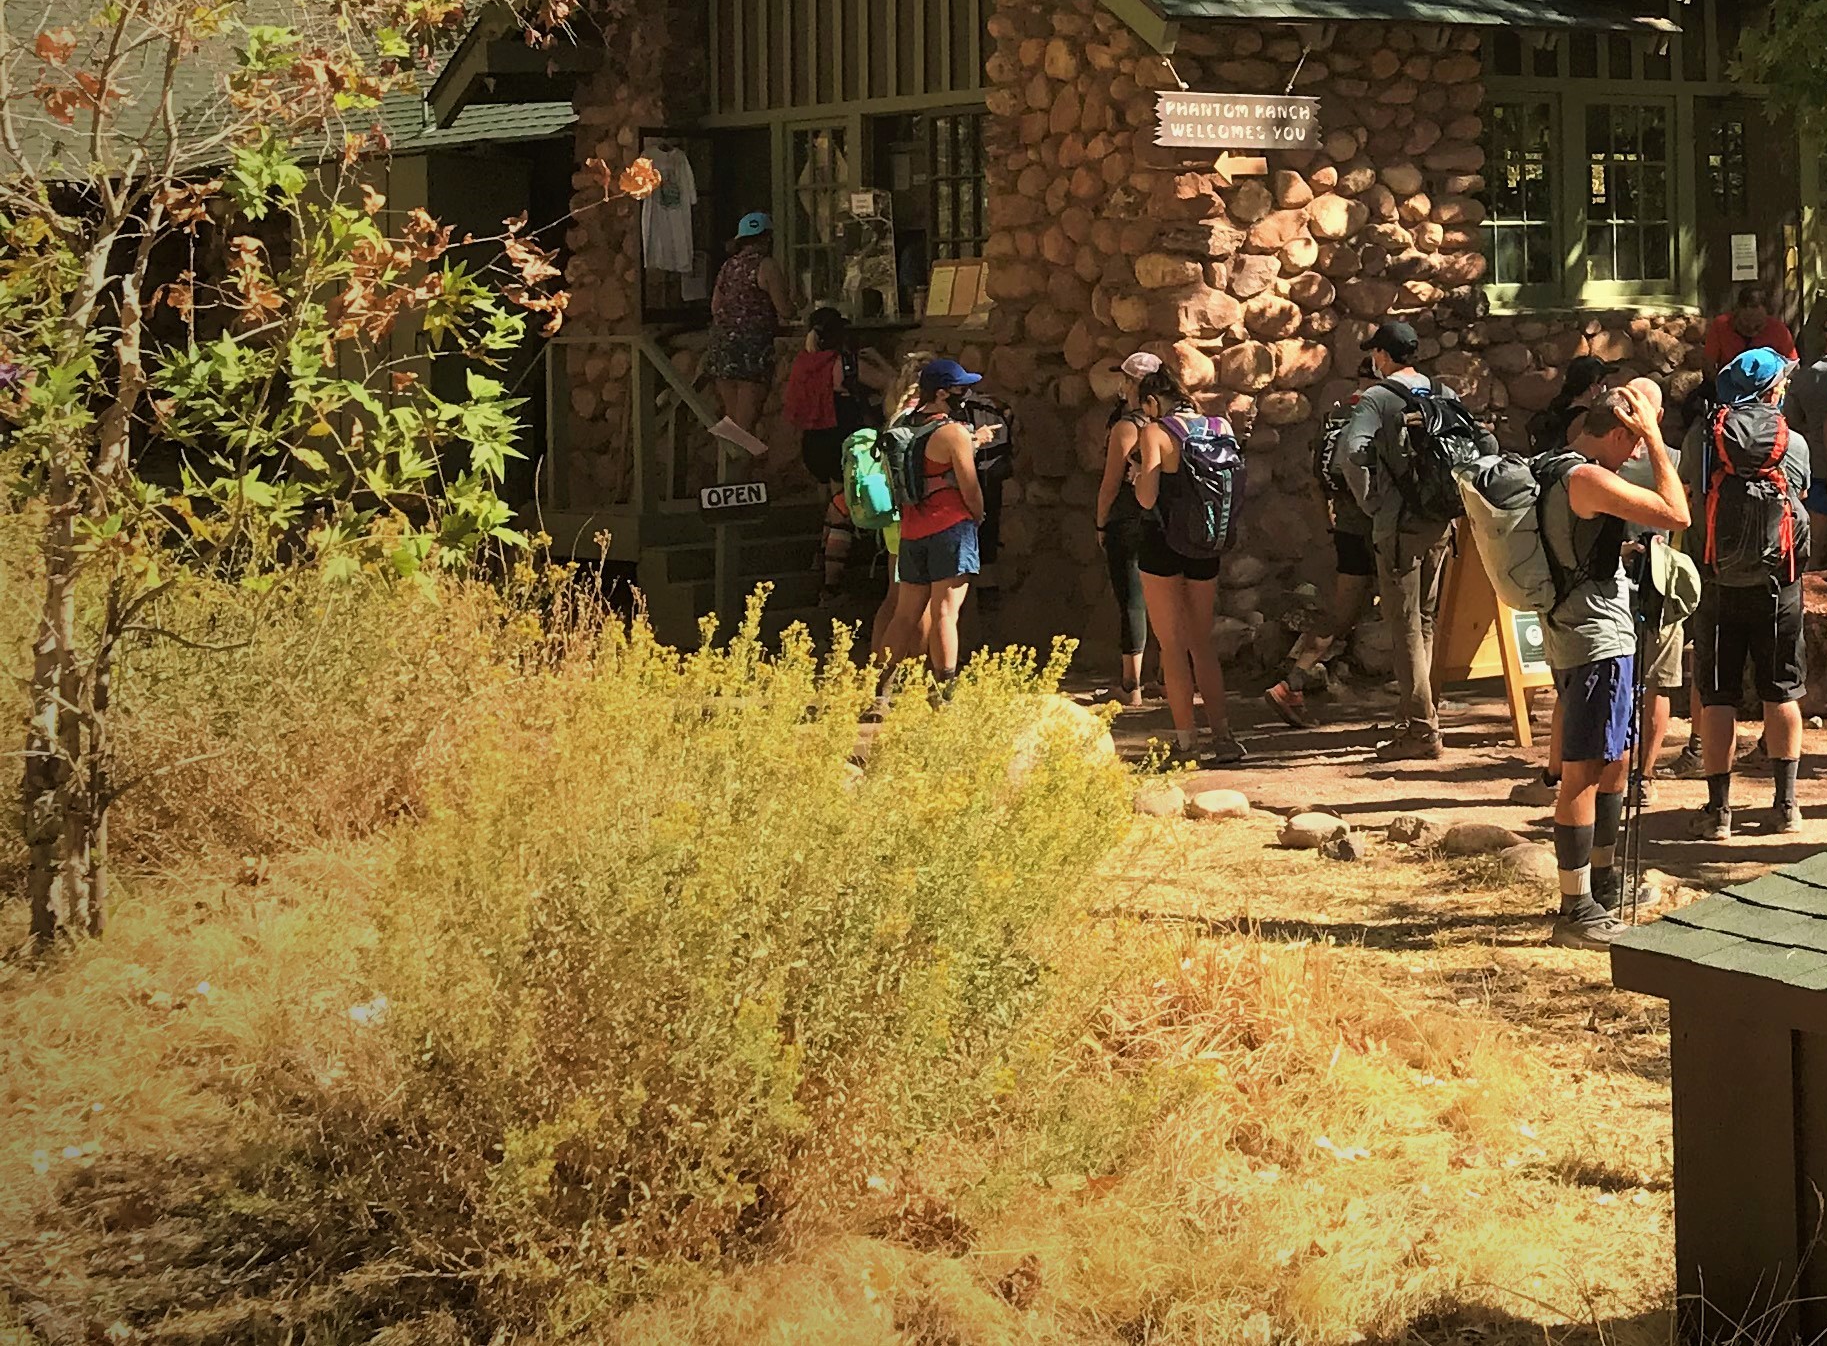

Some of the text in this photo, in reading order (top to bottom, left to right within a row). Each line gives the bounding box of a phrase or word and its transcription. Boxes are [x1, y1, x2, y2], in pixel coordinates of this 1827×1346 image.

[1165, 101, 1311, 120] PHANTOM RANCH
[1170, 123, 1306, 141] WELCOMES YOU
[707, 485, 762, 506] OPEN
